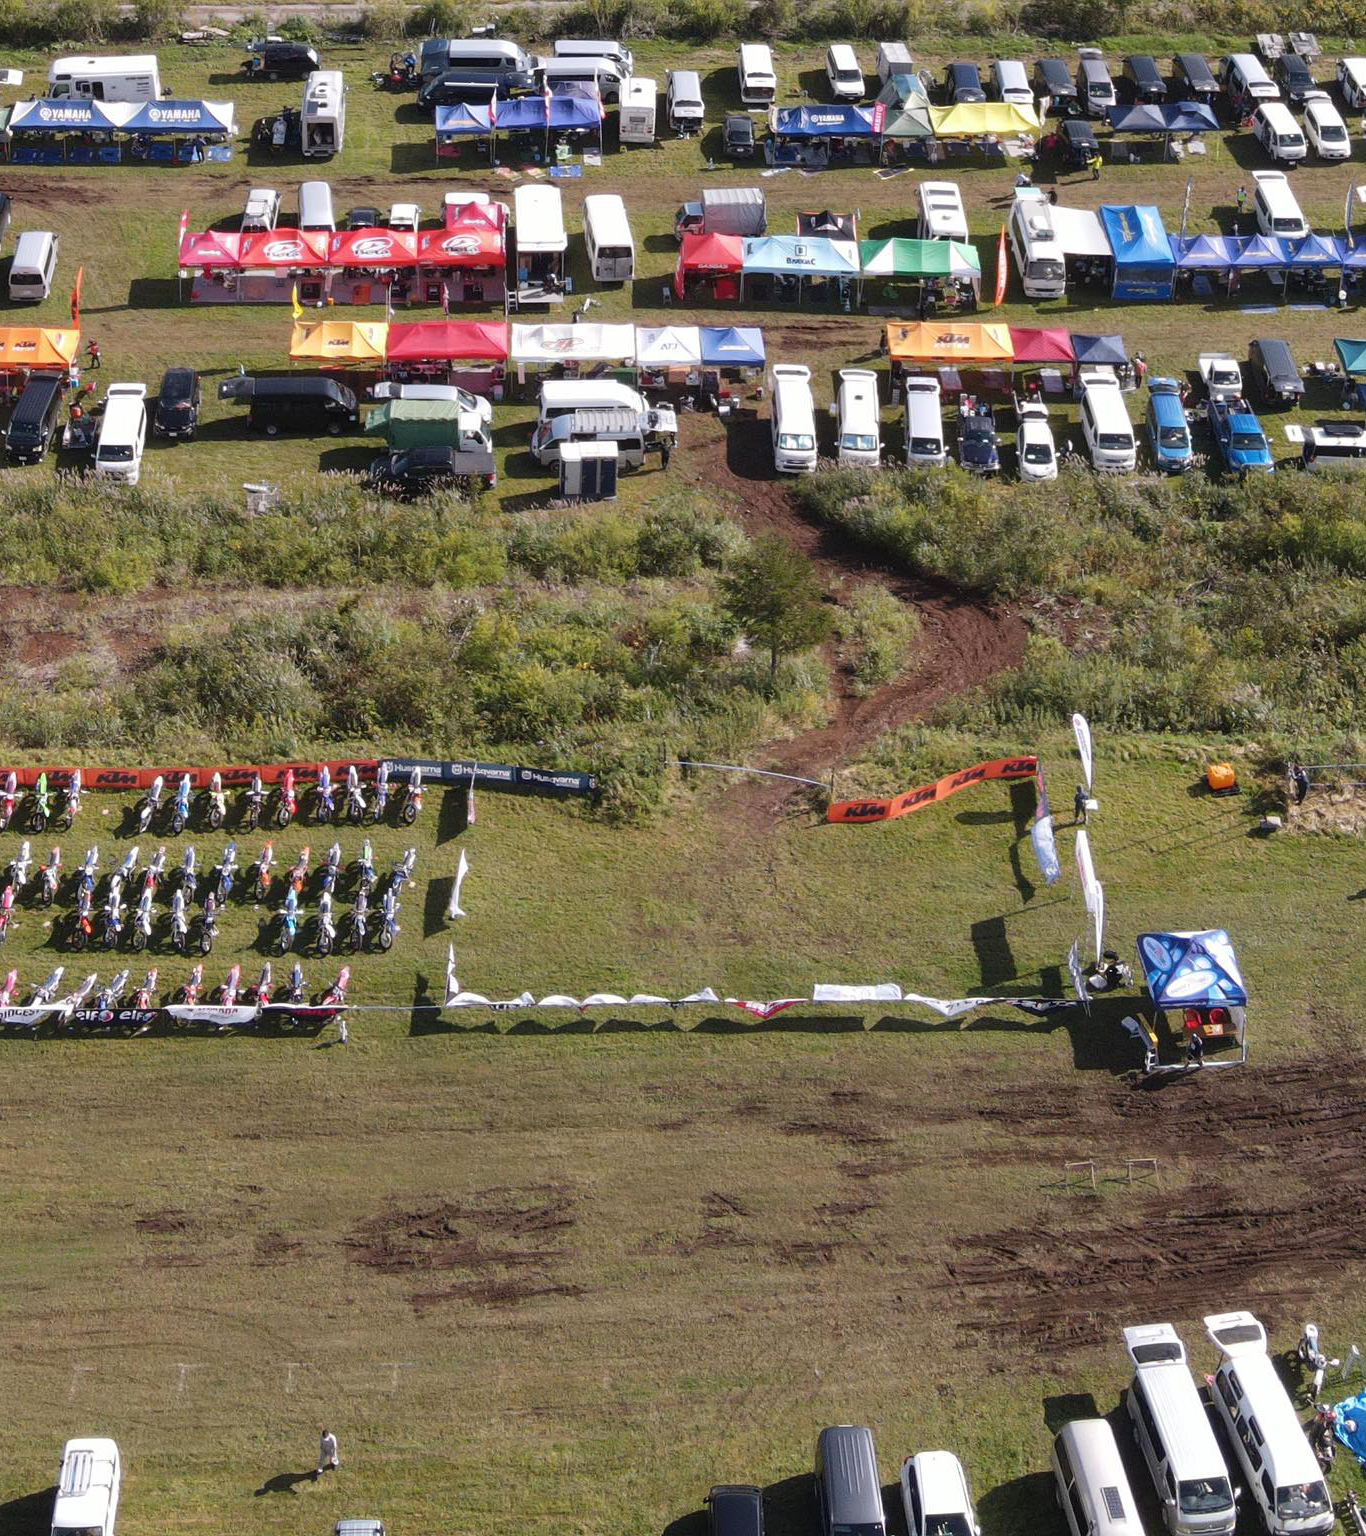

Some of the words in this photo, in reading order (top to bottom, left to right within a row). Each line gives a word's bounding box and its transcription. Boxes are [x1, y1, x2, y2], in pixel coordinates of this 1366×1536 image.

[52, 109, 92, 119] YAMAHA
[161, 109, 201, 119] YAMAHA
[1002, 760, 1036, 773] KTM
[96, 771, 138, 784] KTM
[532, 773, 581, 785] Husqvarna
[950, 769, 986, 788] KTM
[902, 789, 936, 808] KTM
[844, 802, 885, 817] KTM
[76, 1010, 99, 1021] elf
